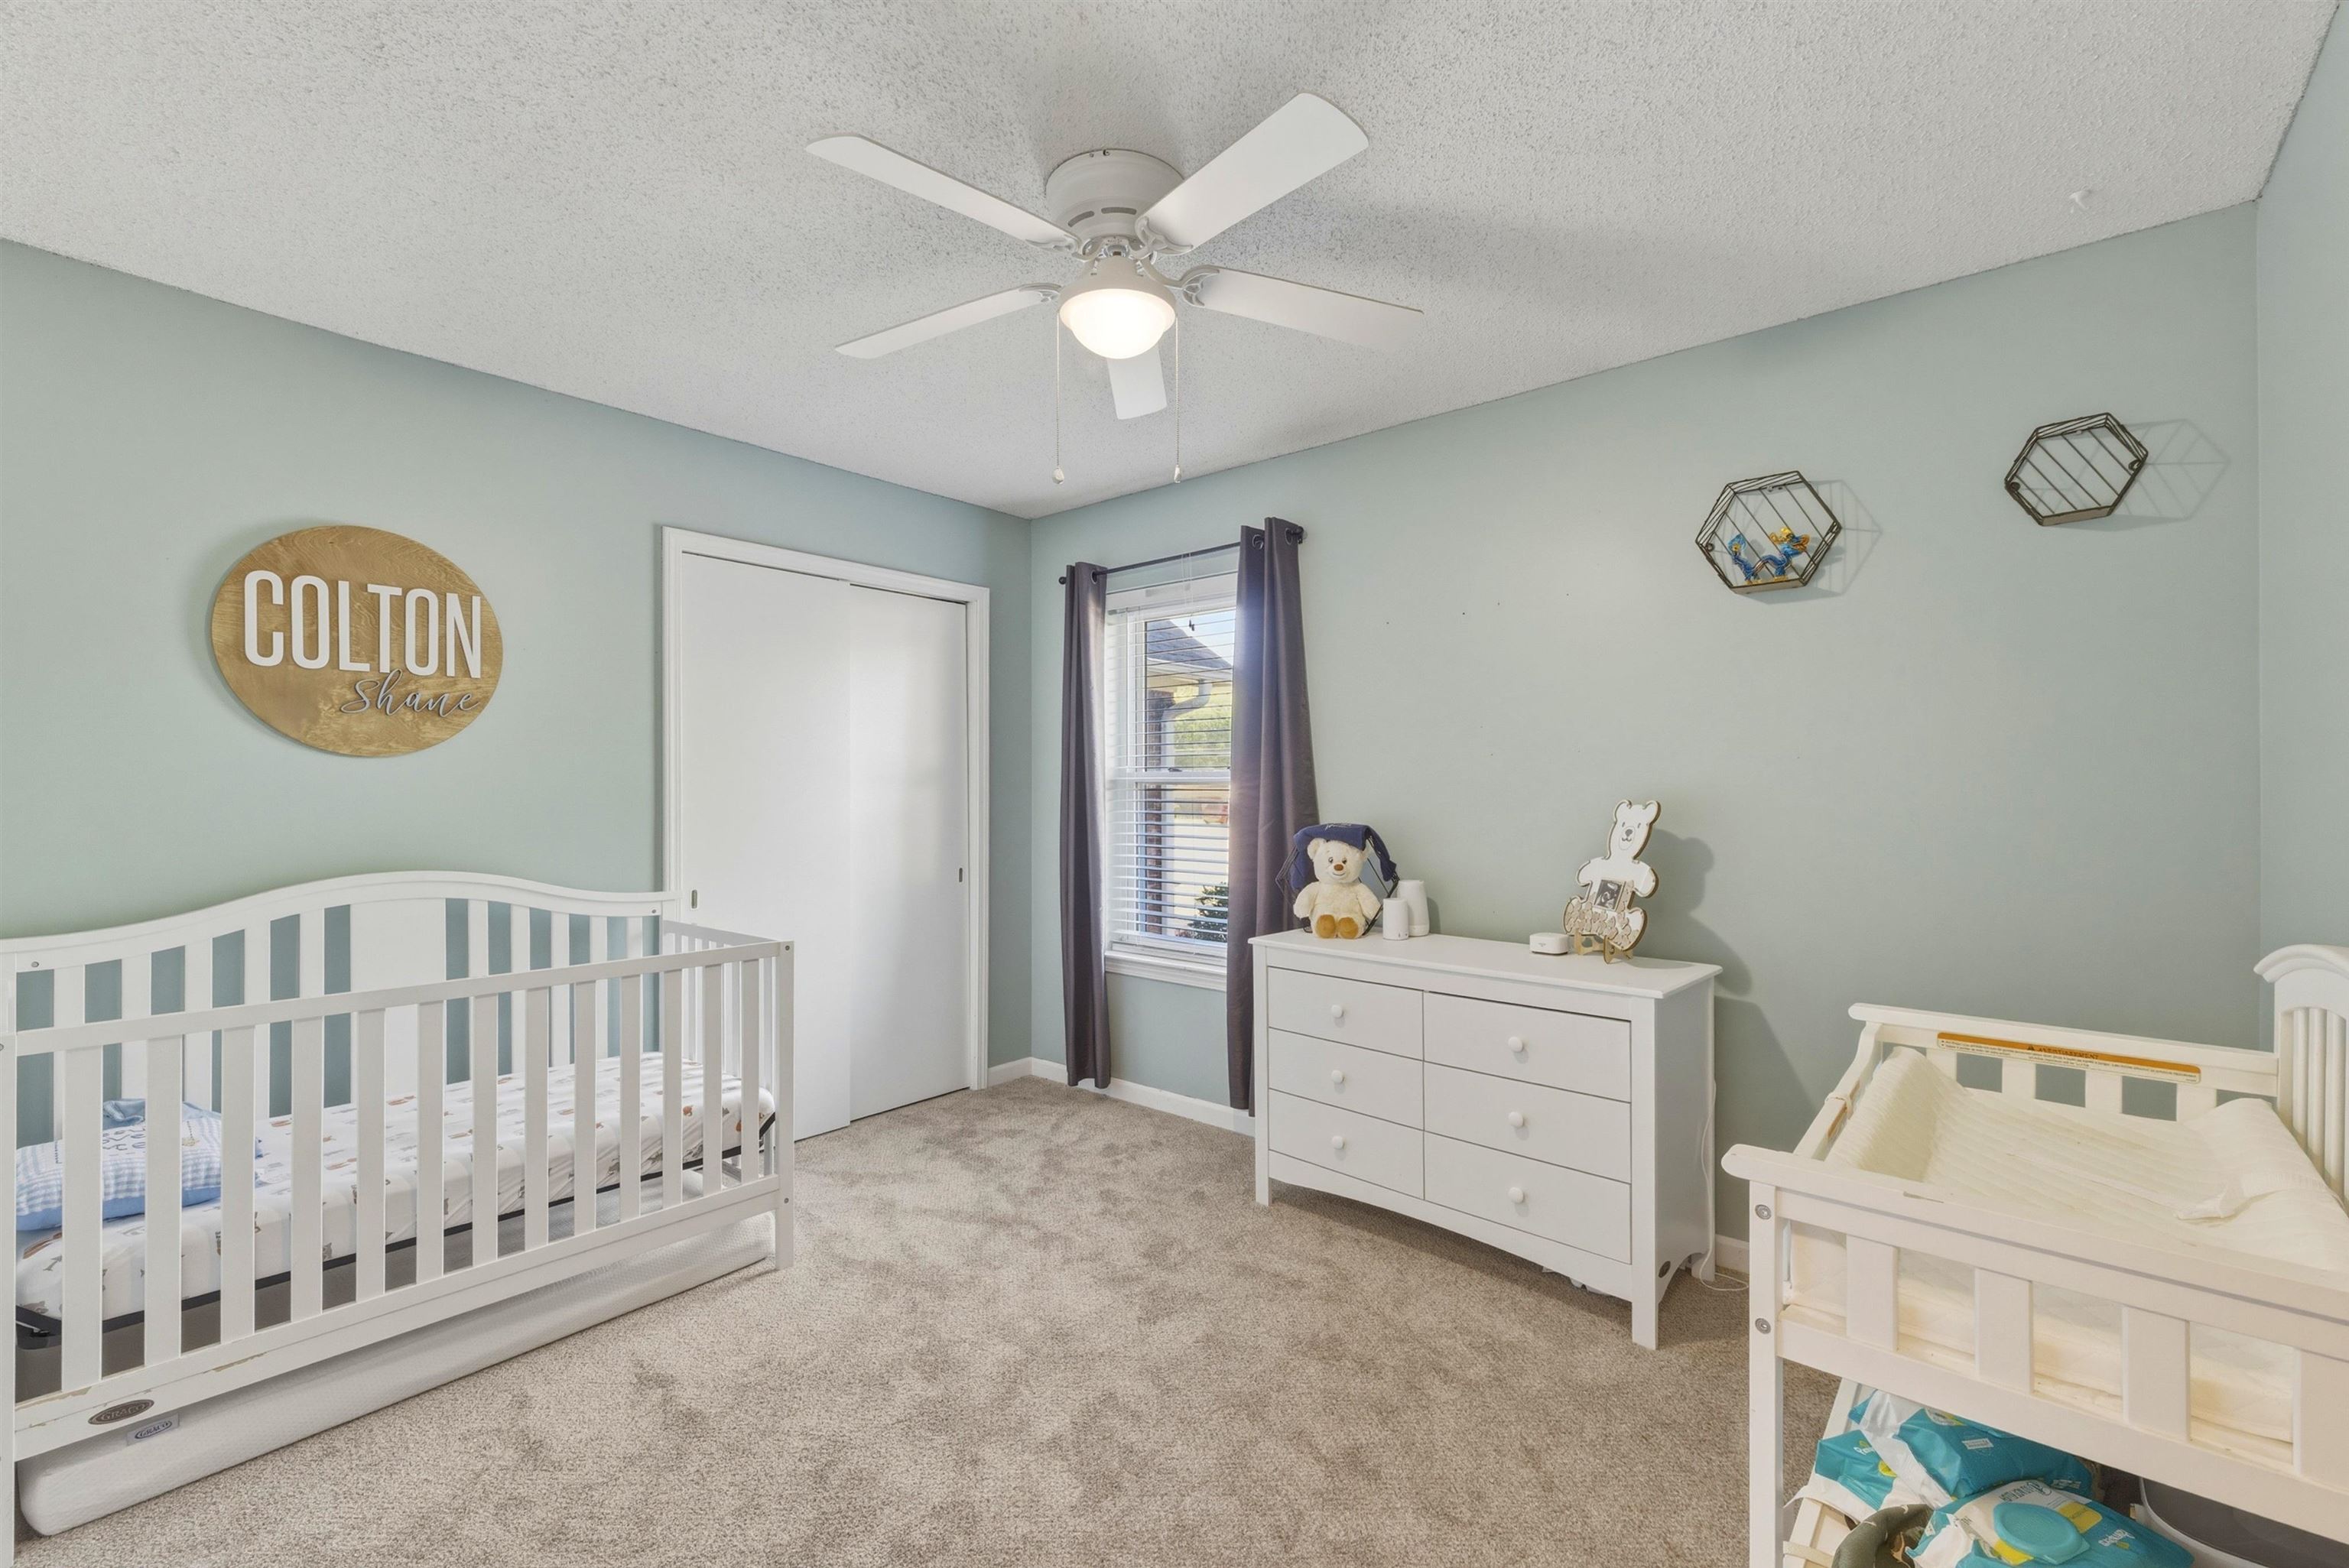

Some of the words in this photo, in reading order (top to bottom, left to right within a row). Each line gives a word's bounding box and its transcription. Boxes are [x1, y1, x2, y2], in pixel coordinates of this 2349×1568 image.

[244, 570, 481, 679] COLTON
[340, 668, 479, 718] Shane
[101, 1403, 145, 1421] GRACO
